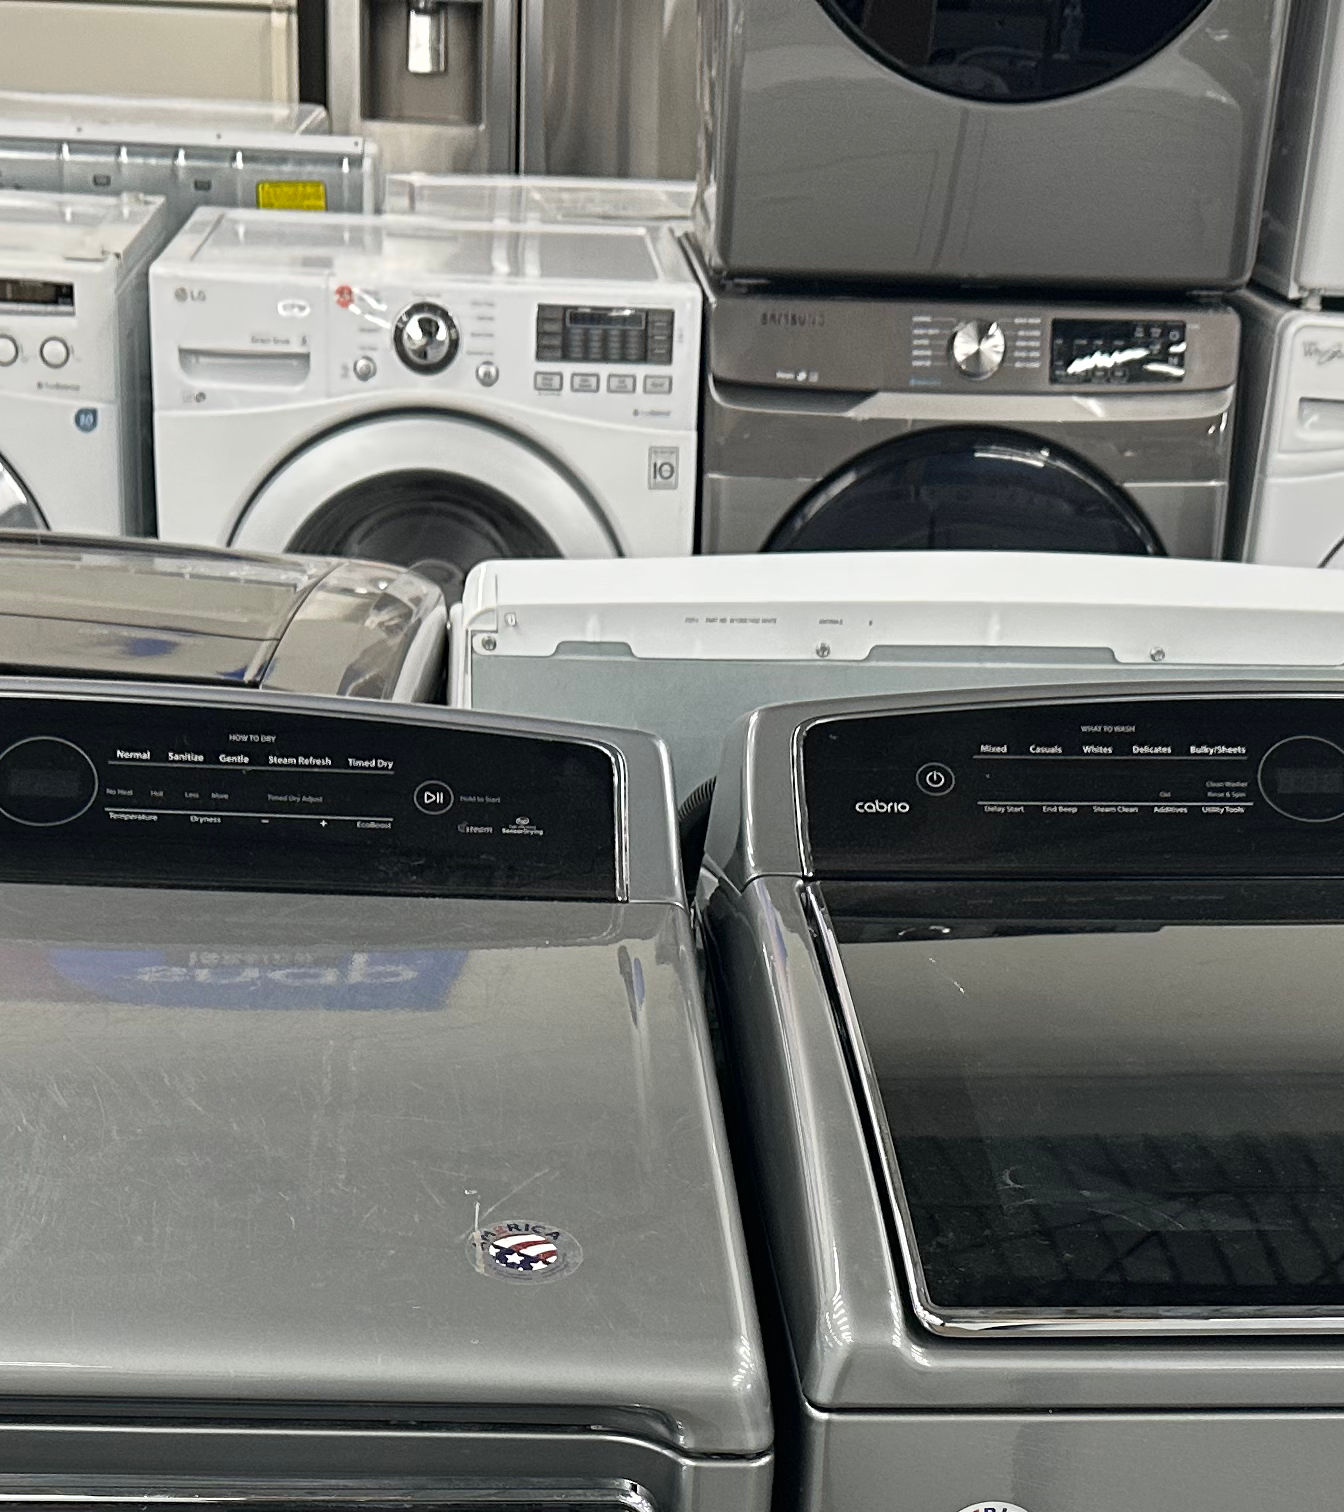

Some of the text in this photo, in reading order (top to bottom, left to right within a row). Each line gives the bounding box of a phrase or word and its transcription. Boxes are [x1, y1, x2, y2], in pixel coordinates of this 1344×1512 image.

[1081, 725, 1102, 734] WHAT
[1114, 725, 1136, 734] WASH
[229, 733, 249, 743] HOW
[250, 734, 260, 743] TO
[980, 744, 1007, 754] Mixed
[1029, 744, 1062, 755] Casuals
[1082, 745, 1113, 755] Whites
[1132, 744, 1172, 755] Delicates
[1189, 744, 1246, 756] Bulky/Sheets
[116, 749, 151, 761] Normal
[168, 751, 204, 763] Sanitize
[218, 753, 250, 765] Gentle
[268, 755, 332, 767] Steam Refresh
[348, 757, 394, 770] Timed Dry
[855, 799, 910, 813] cabrio
[984, 805, 1024, 815] Delay Start
[1042, 805, 1078, 815] End Beep
[1117, 805, 1139, 814] Clean
[1224, 805, 1245, 814] Tools
[108, 811, 158, 823] Temperature
[190, 814, 222, 825] Dryness
